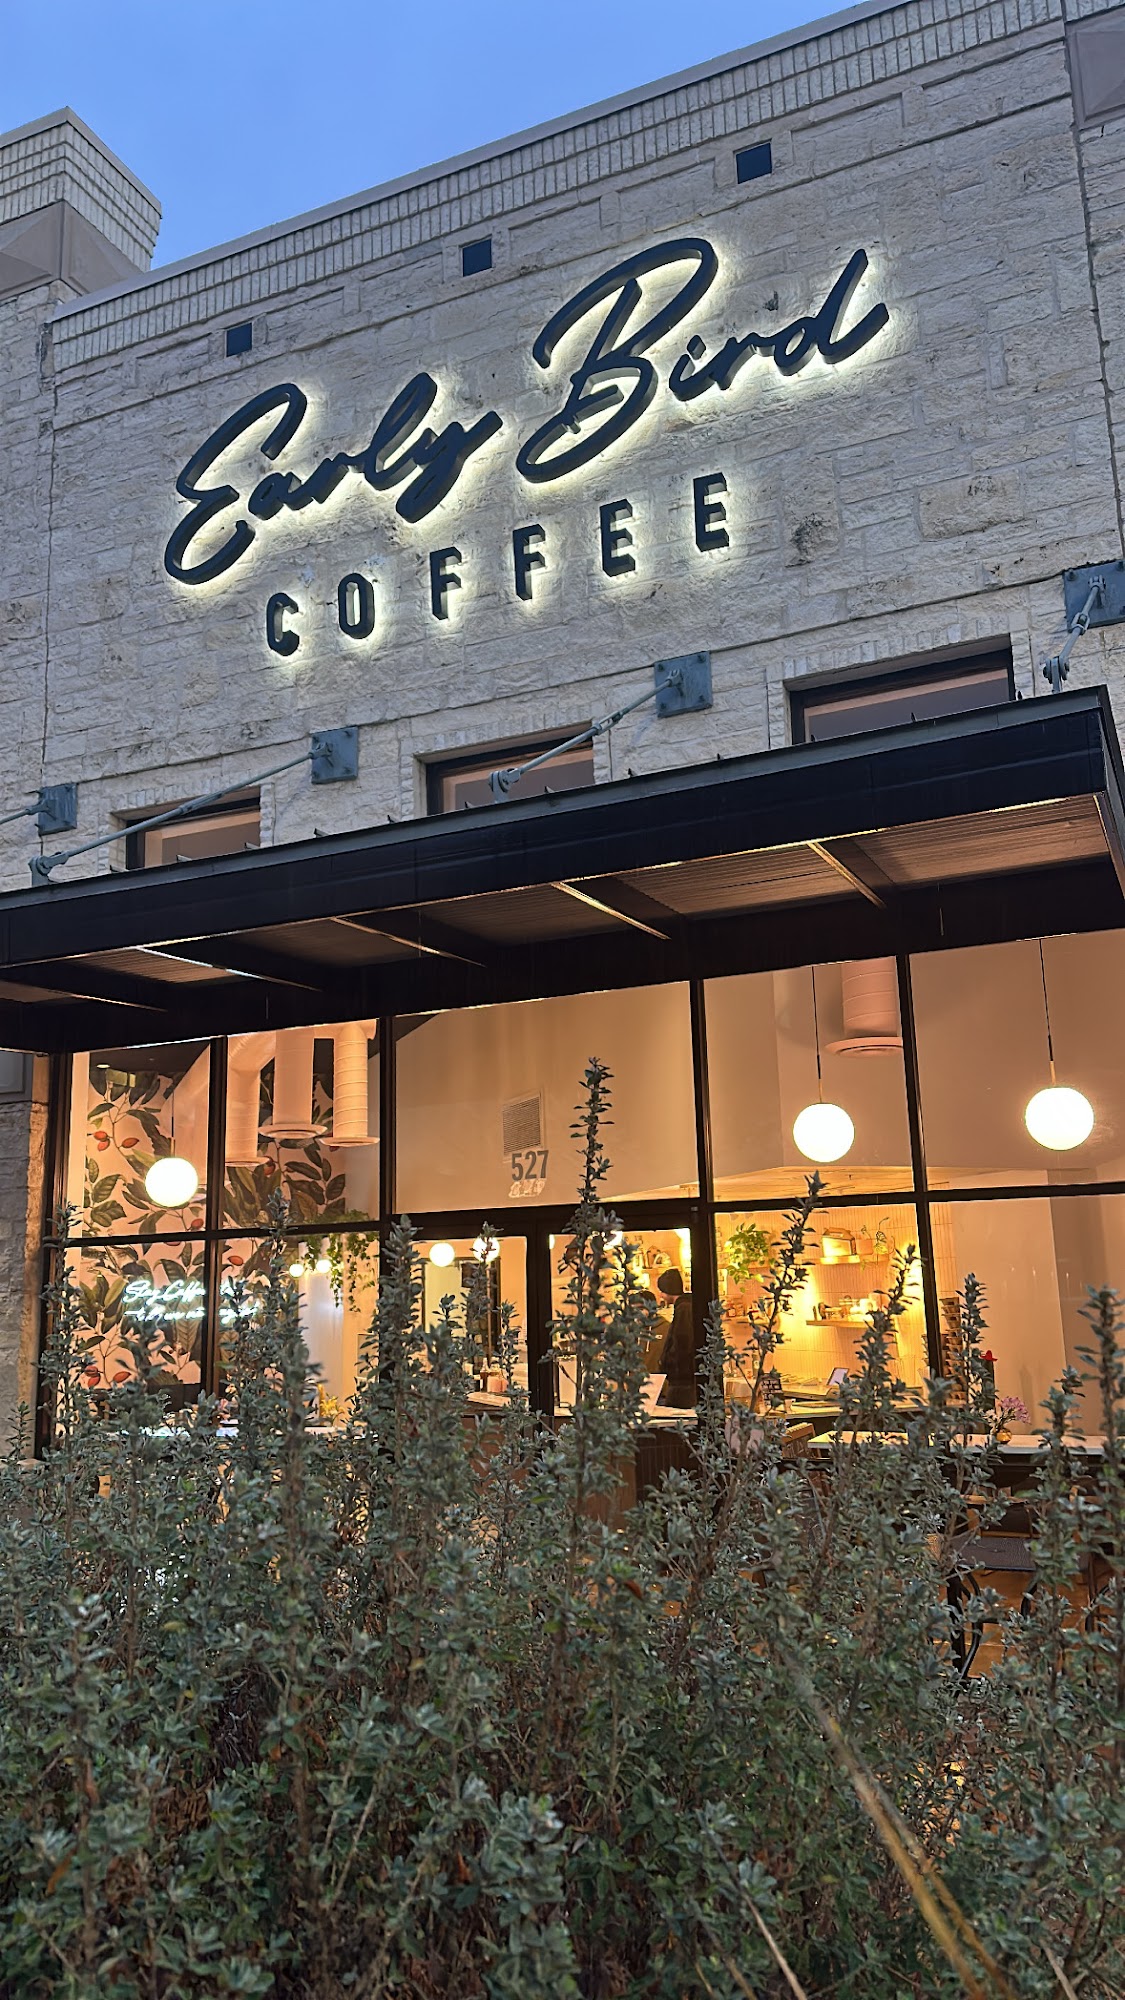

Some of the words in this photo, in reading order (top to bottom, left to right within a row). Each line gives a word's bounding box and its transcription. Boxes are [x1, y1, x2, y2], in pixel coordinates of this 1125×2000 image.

[164, 373, 504, 585] Early
[515, 237, 889, 483] Bird
[266, 471, 730, 656] COFFEE
[511, 1149, 549, 1182] 527
